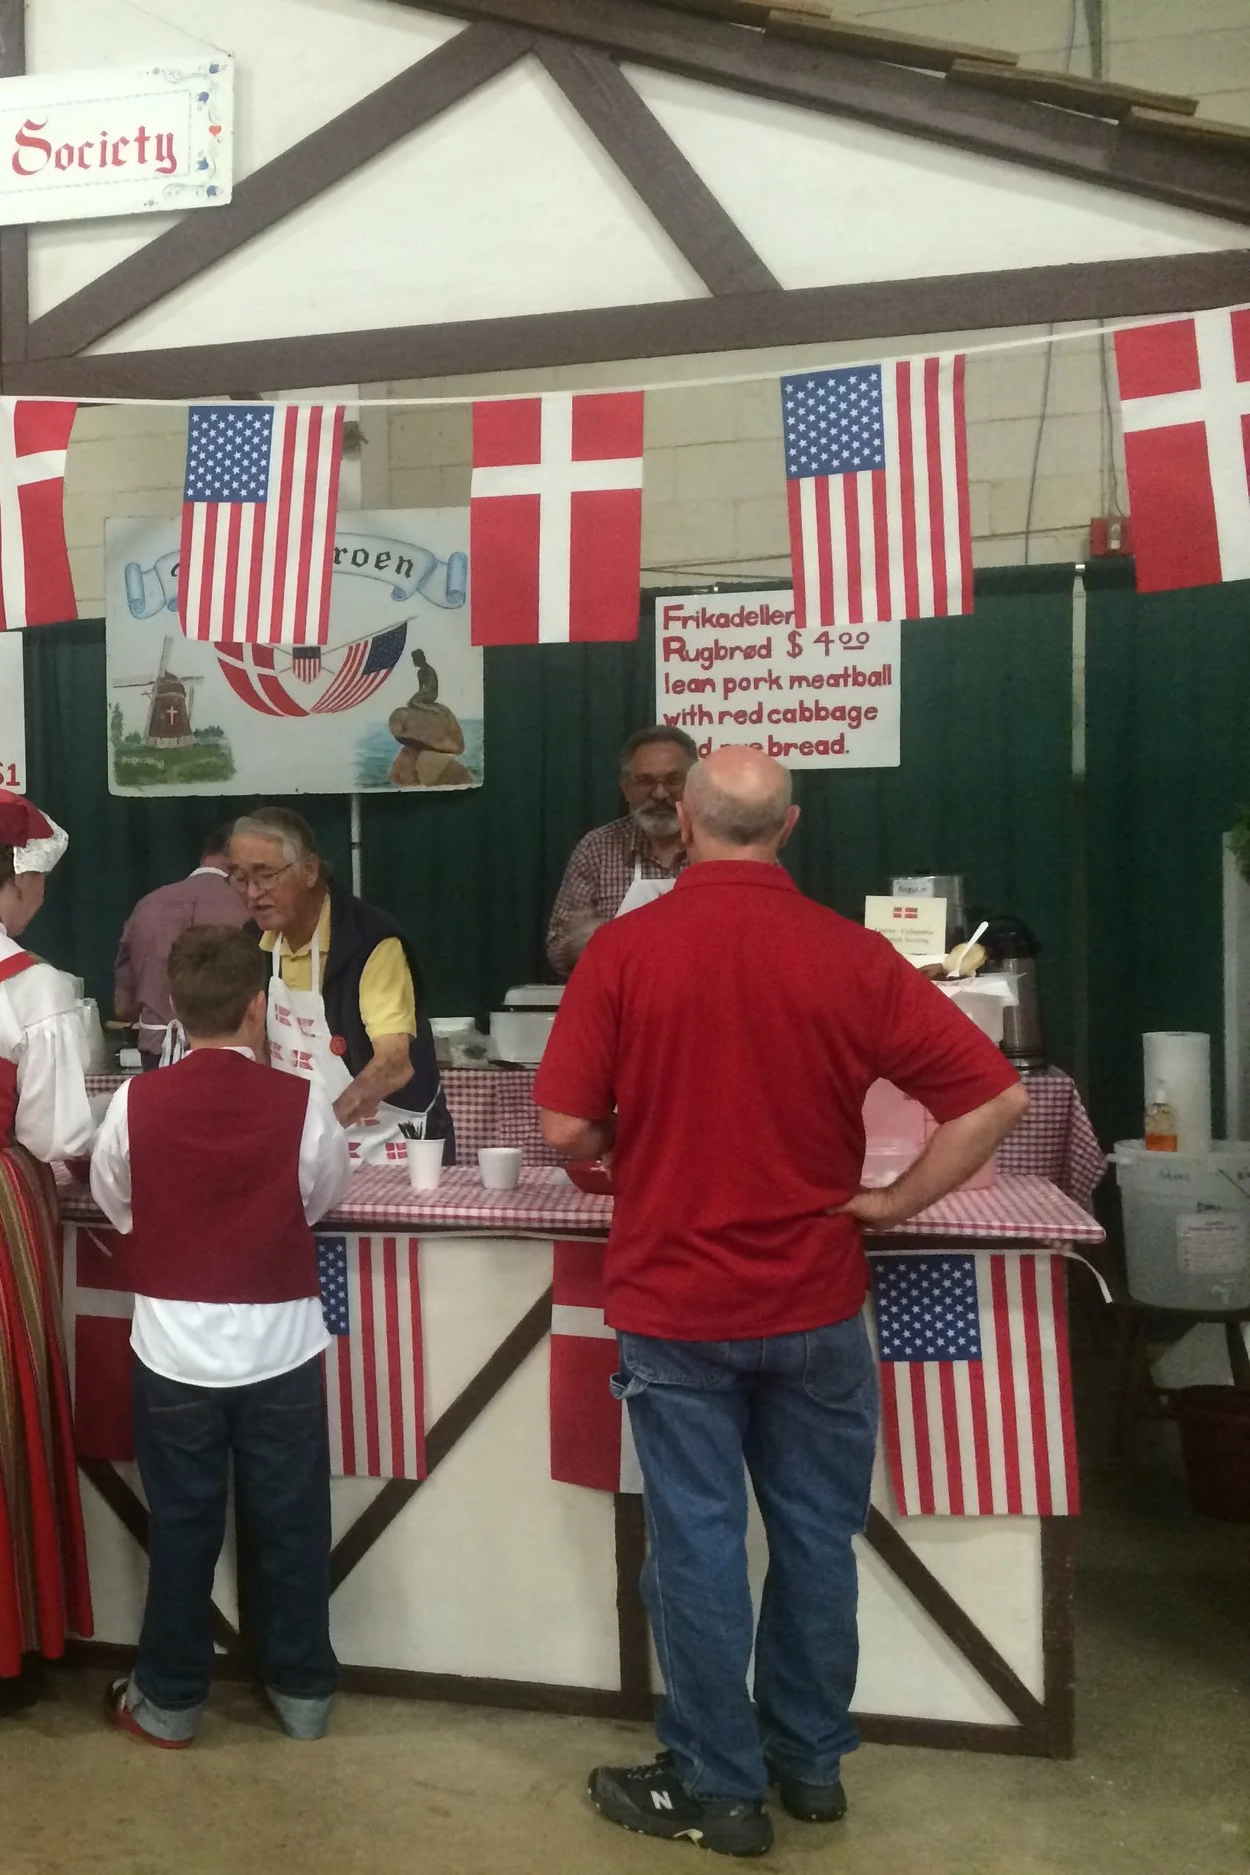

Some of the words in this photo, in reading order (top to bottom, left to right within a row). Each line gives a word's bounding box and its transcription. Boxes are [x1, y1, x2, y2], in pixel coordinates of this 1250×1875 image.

[11, 115, 178, 176] Society
[663, 636, 772, 670] Rugbrød
[664, 672, 716, 694] lean
[723, 669, 784, 700] pork
[789, 664, 892, 689] meatball
[663, 704, 714, 728] with
[718, 701, 763, 725] red
[767, 700, 878, 729] cabbage
[768, 732, 850, 757] bread.
[651, 1790, 673, 1810] N
